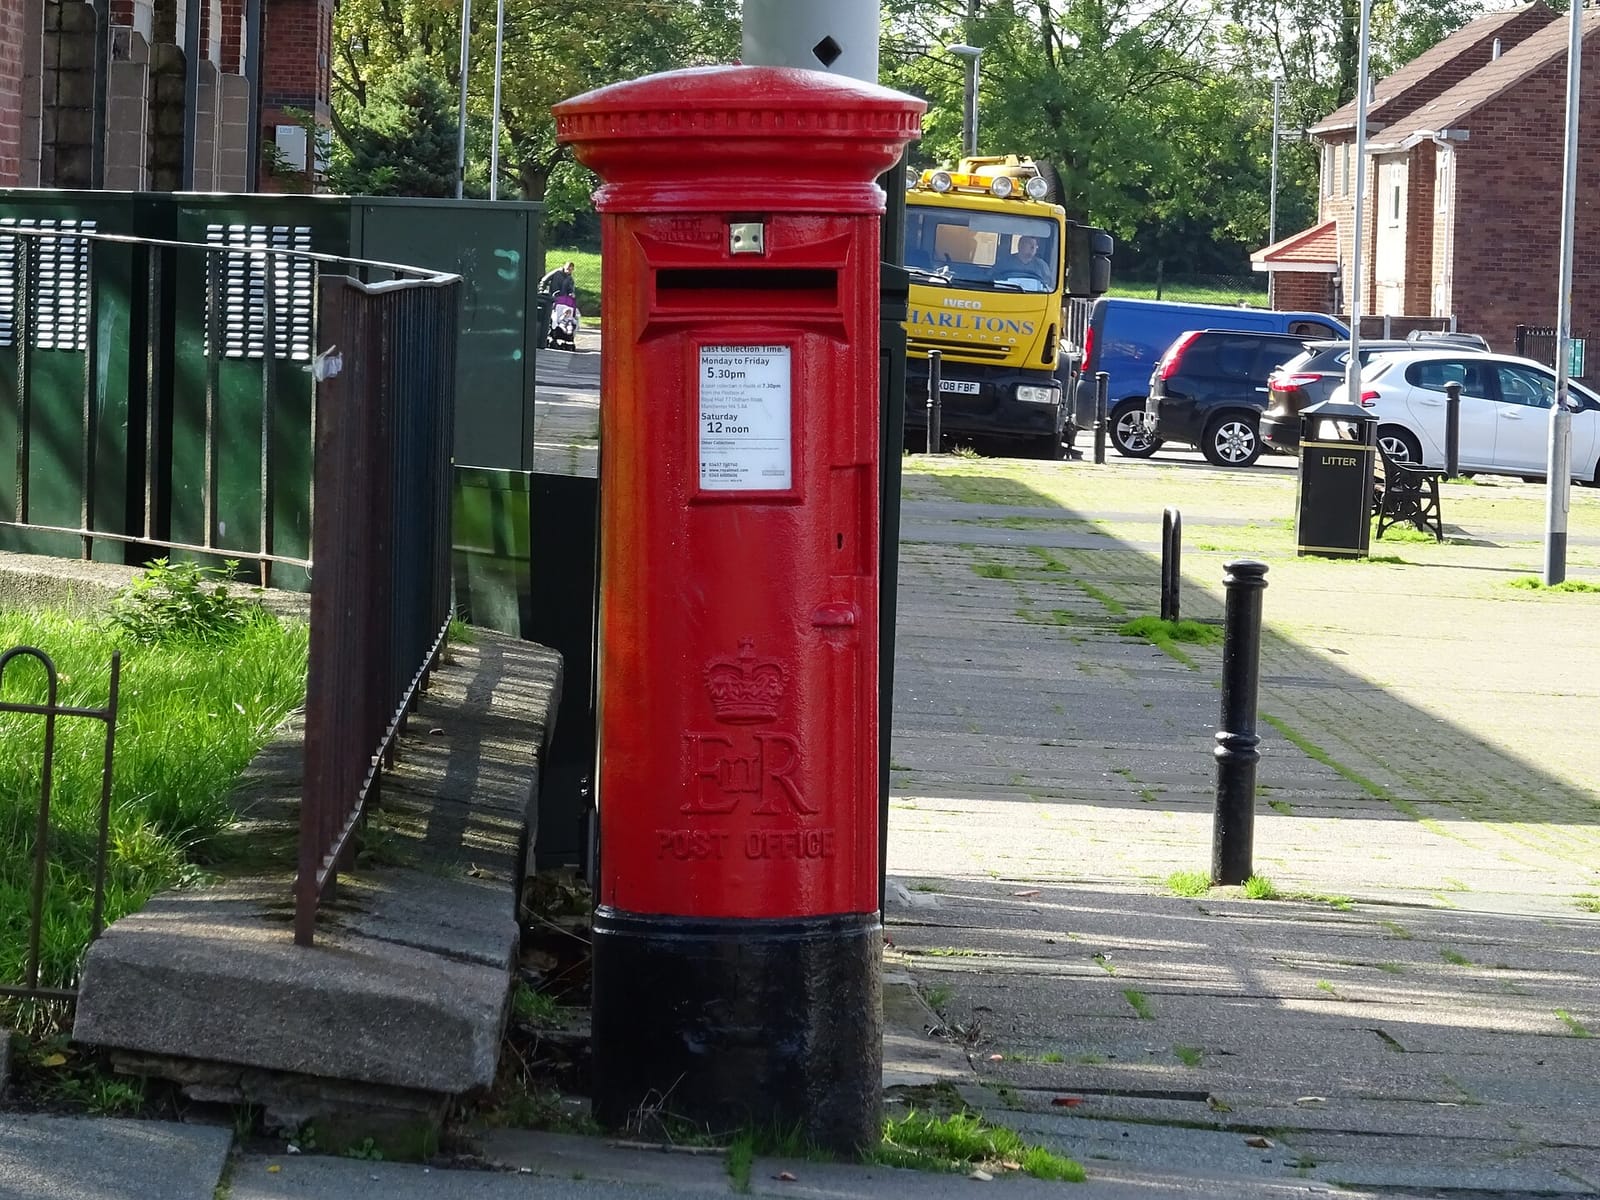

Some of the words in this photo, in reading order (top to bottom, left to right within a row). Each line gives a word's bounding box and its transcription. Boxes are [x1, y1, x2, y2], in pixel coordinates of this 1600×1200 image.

[943, 298, 982, 309] IVECO
[907, 309, 1035, 336] HARLTONS
[701, 357, 733, 366] Monday
[744, 357, 770, 366] Friday
[707, 366, 746, 380] 5.30pm
[957, 382, 976, 393] FBF
[701, 412, 738, 421] Saturday
[707, 421, 723, 433] 12
[1322, 456, 1357, 467] LITTER
[655, 829, 730, 861] POST
[744, 828, 837, 861] OFFICE
